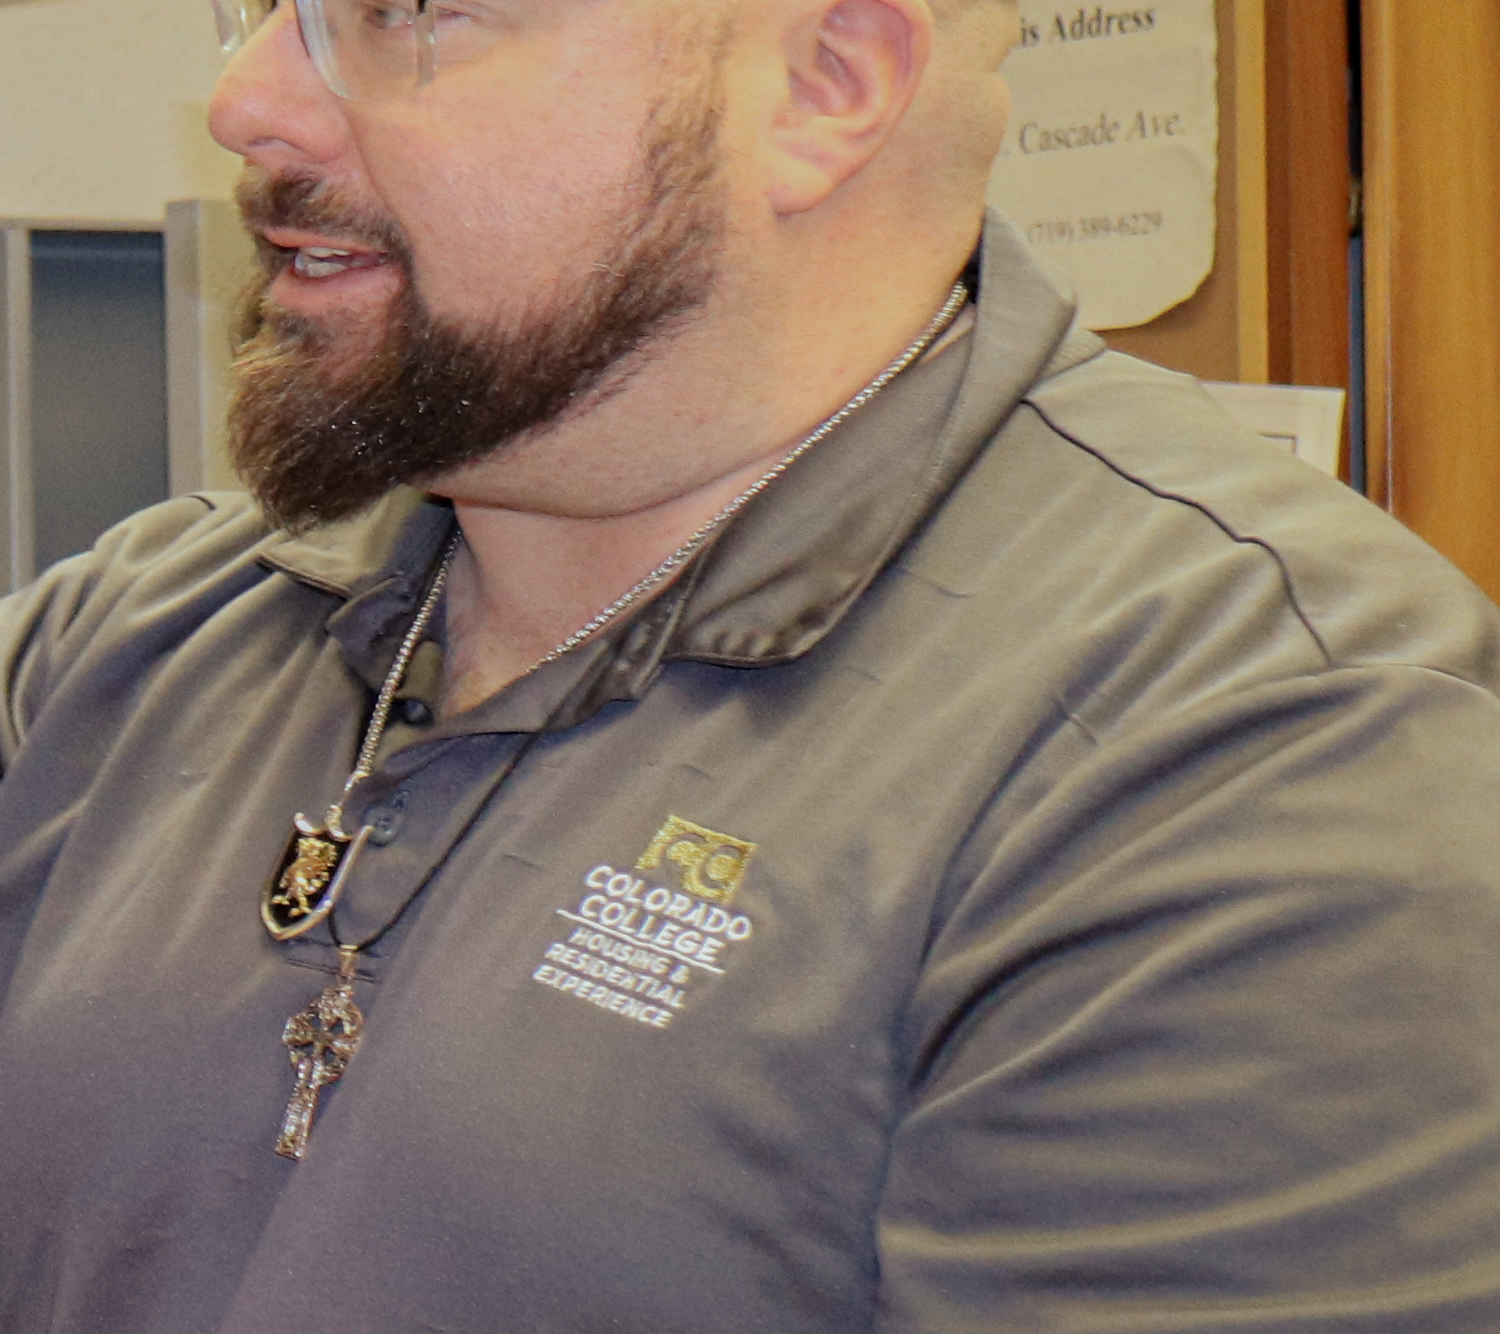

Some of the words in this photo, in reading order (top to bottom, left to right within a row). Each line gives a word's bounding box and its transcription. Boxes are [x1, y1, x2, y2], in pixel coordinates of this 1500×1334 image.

[1048, 7, 1156, 43] Address
[1019, 114, 1121, 154] Cascade
[580, 894, 726, 963] COLLEGE
[584, 865, 752, 941] COLORADO
[544, 943, 686, 1009] RESIDENTIAL
[569, 927, 671, 975] HOUSING
[669, 965, 691, 984] &
[532, 965, 674, 1029] EXPERIENCE
